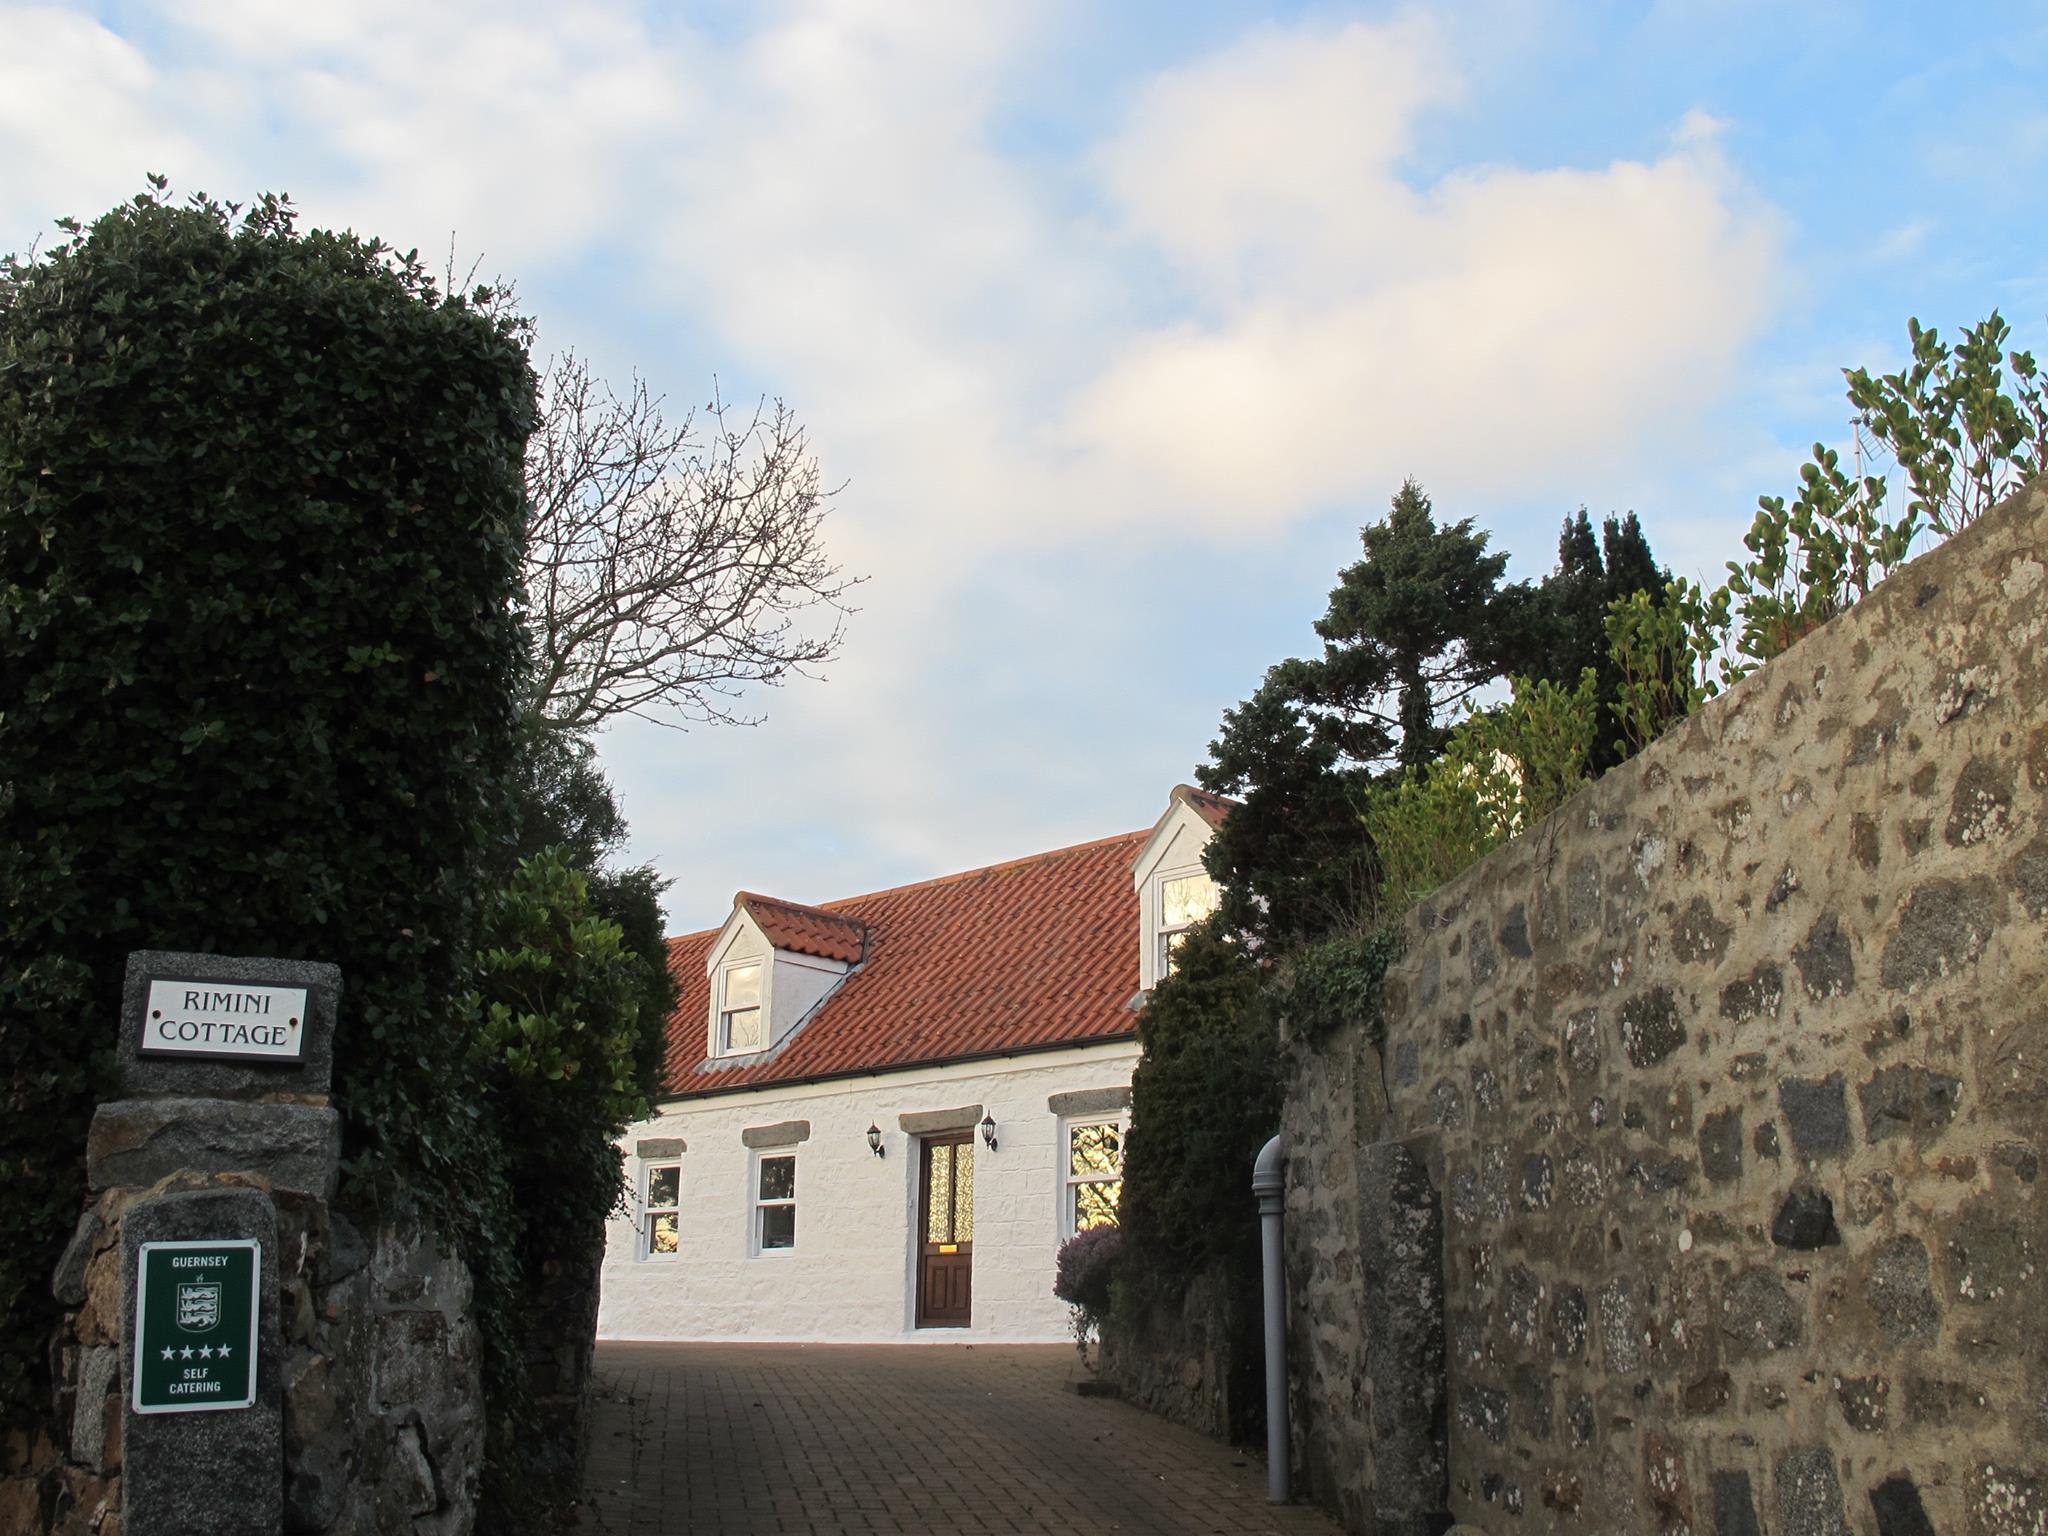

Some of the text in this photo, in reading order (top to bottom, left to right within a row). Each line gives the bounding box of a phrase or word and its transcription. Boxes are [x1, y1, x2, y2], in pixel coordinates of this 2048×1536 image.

[183, 990, 271, 1014] RIMINI
[159, 1020, 287, 1046] COTTAGE
[172, 1256, 229, 1268] GUERNSEY
[183, 1367, 209, 1379] SELF
[169, 1381, 221, 1394] CATERING
